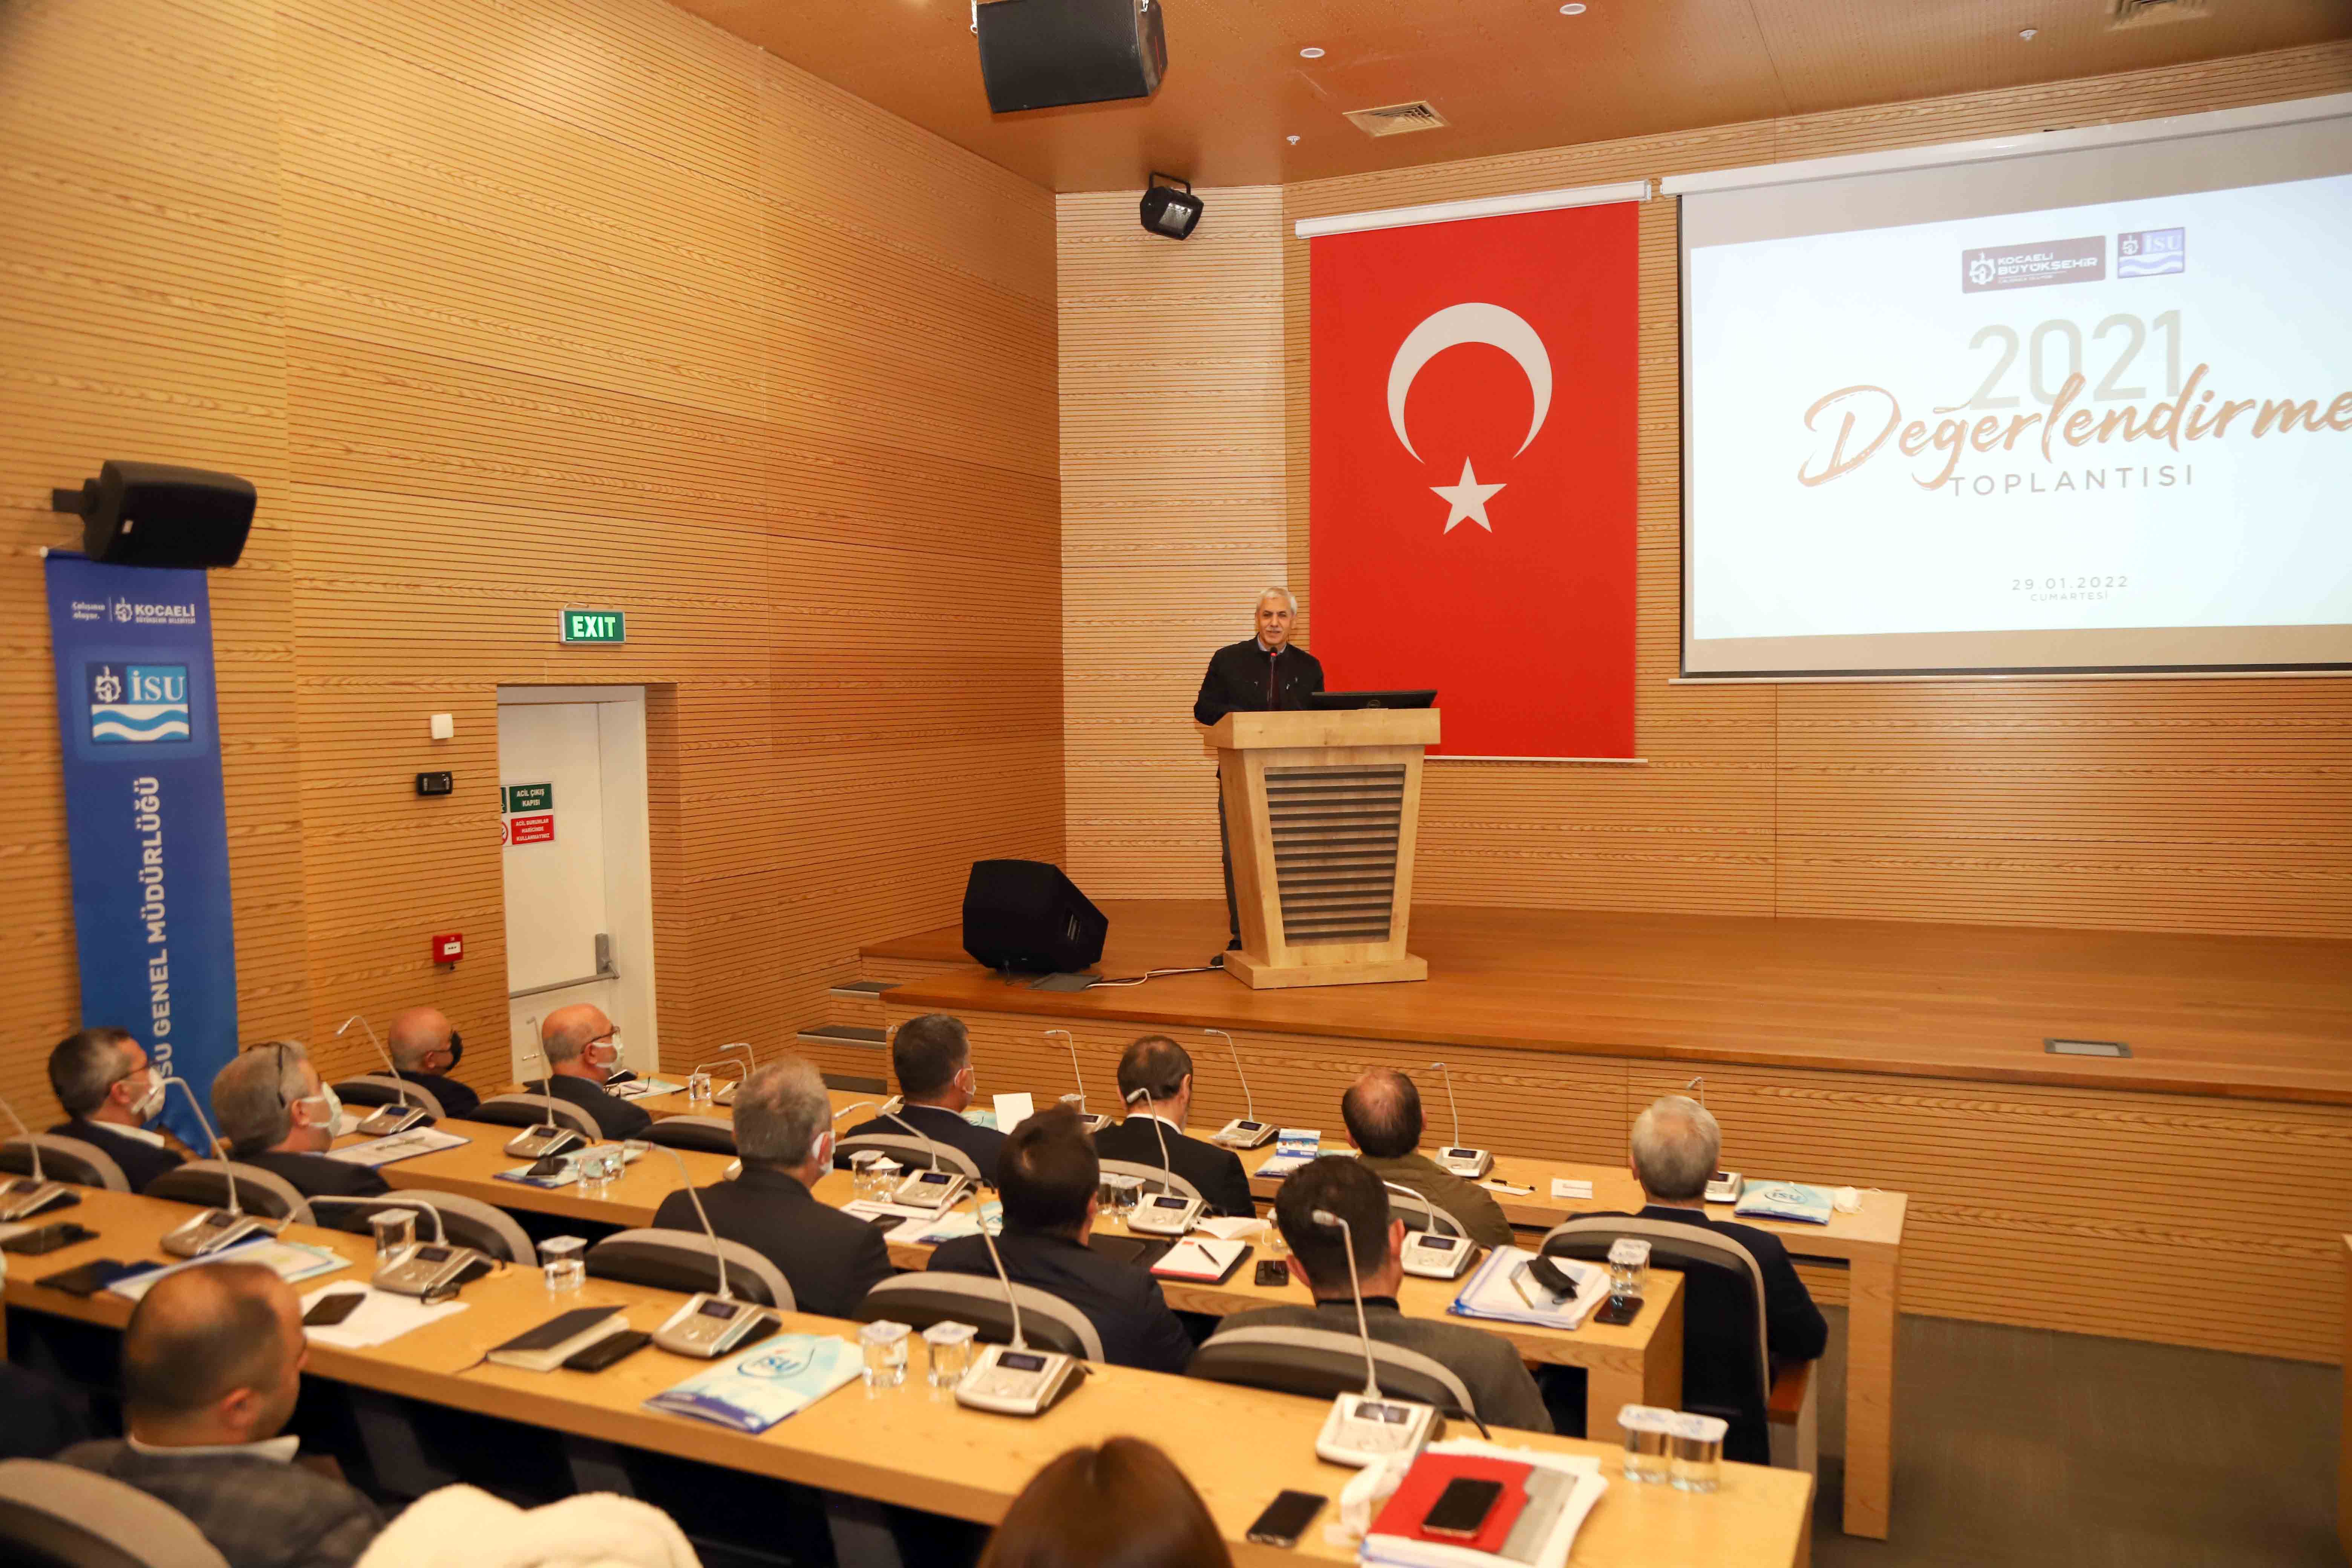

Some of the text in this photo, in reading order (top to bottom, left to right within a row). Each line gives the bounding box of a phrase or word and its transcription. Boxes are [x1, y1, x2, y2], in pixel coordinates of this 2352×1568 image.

[1998, 252, 2054, 265] KOCAELİ
[1998, 257, 2098, 275] BÜYÜKŞEHİR
[1968, 309, 2182, 411] 2021
[1798, 363, 2352, 491] Değerlendirme
[1948, 464, 2192, 497] TOPLANTISI
[2012, 576, 2128, 591] 29.01.2022
[2030, 590, 2108, 602] CUMARTESİ
[135, 604, 195, 617] KOCAELİ
[573, 616, 616, 637] EXIT
[132, 670, 184, 701] İSU
[530, 789, 545, 797] ÇIKIŞ
[133, 776, 173, 1077] SU GENEL MÜDÜRLÜĞÜ
